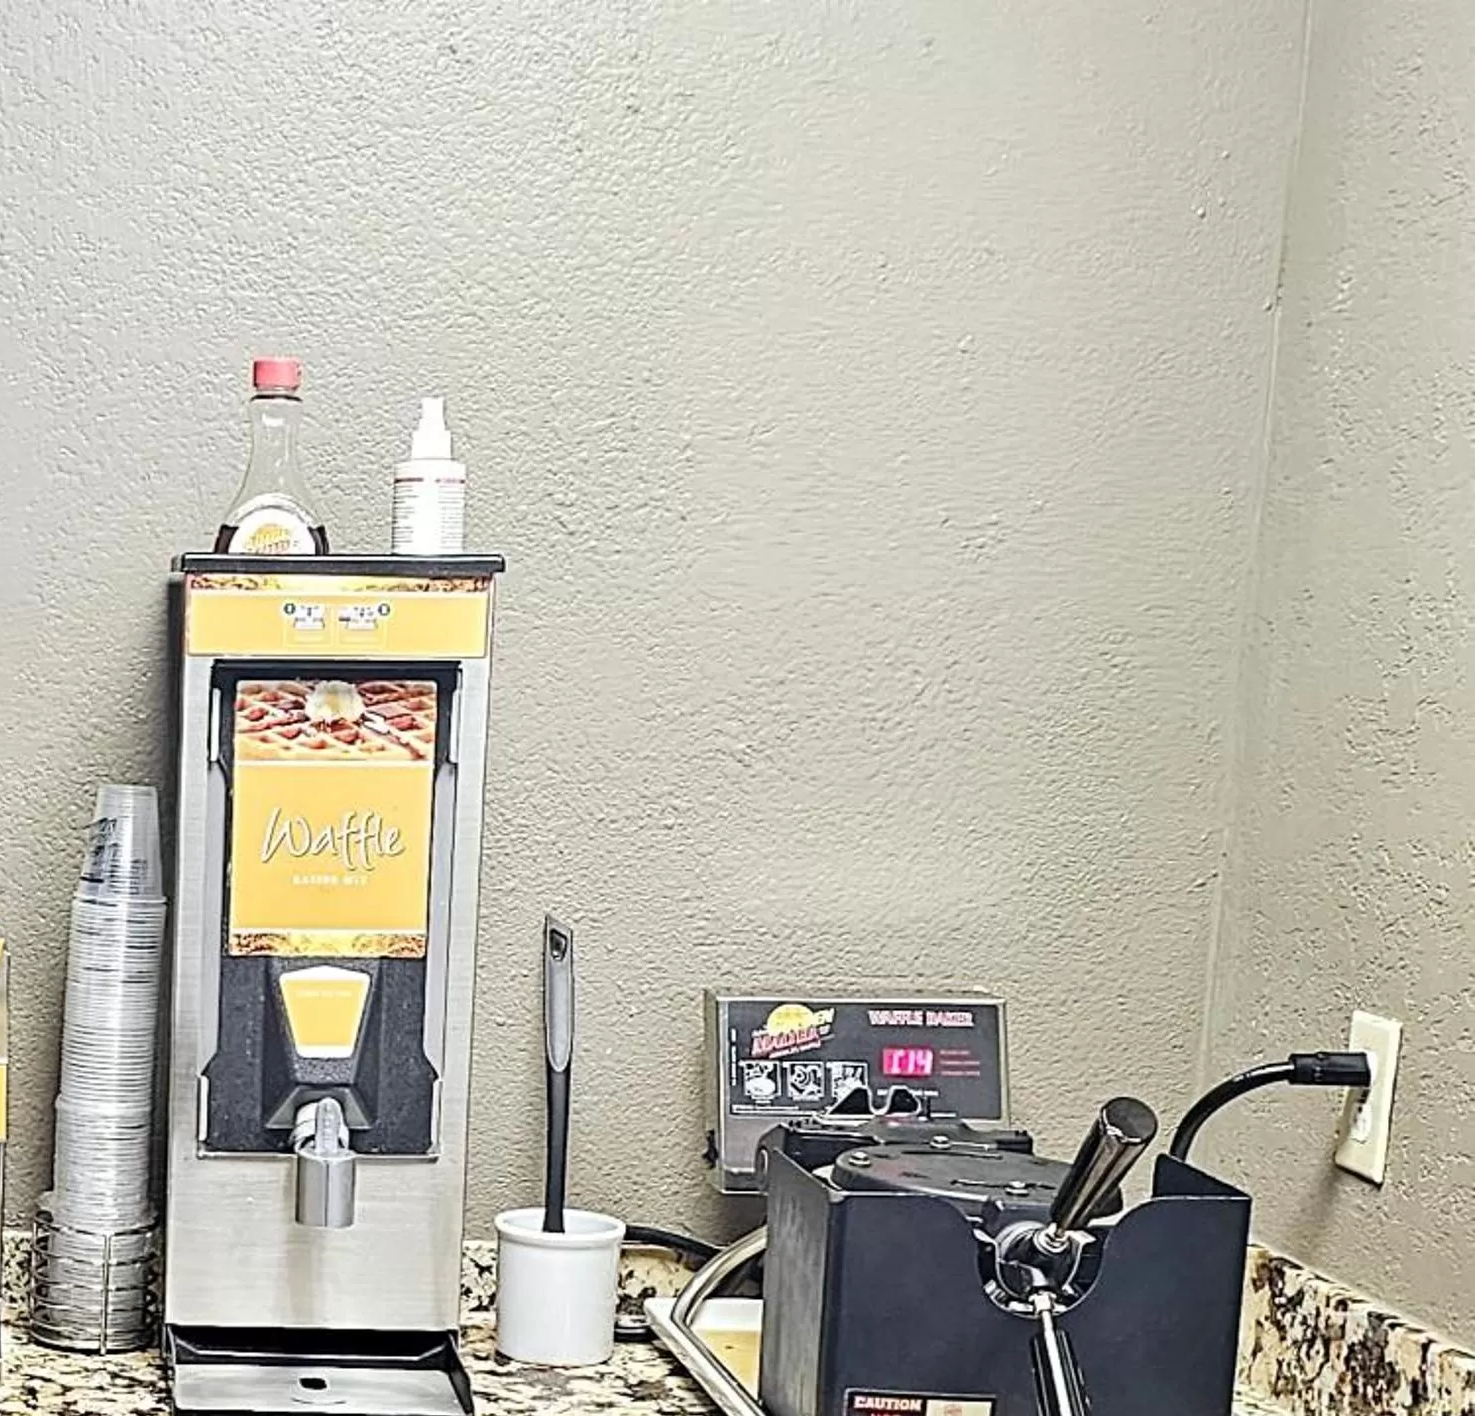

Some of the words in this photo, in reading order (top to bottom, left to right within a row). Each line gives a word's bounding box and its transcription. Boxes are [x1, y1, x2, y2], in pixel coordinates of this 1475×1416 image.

[260, 807, 407, 872] Waffle
[867, 1009, 924, 1026] WAFFLE
[853, 1395, 923, 1411] CAUTION
